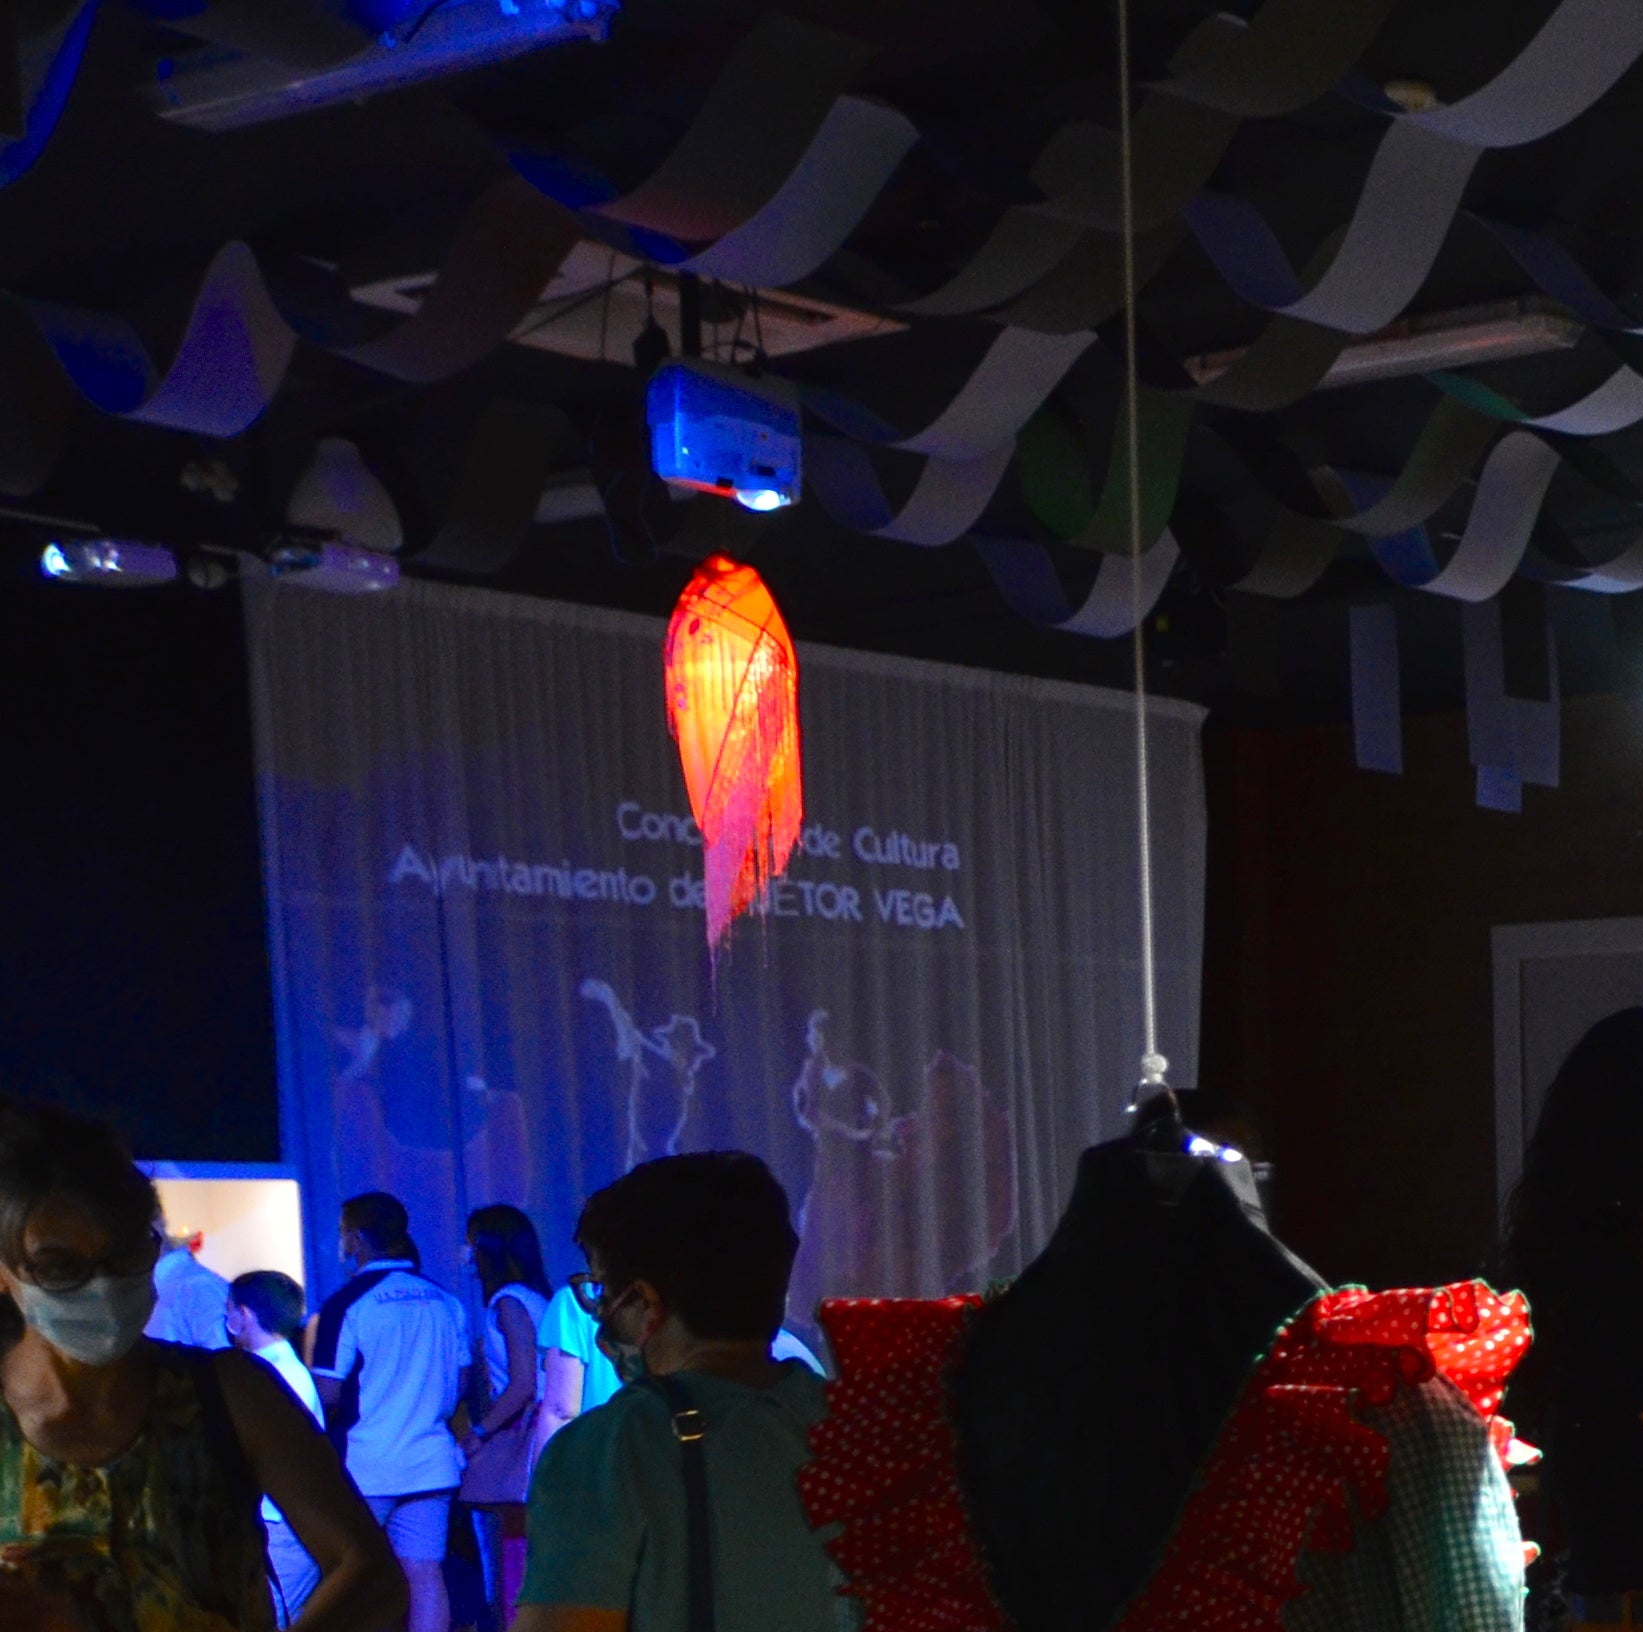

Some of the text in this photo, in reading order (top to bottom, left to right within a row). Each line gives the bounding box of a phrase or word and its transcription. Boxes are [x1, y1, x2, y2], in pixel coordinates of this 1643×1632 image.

[802, 821, 961, 870] de Cultura
[872, 886, 965, 930] VEGA
